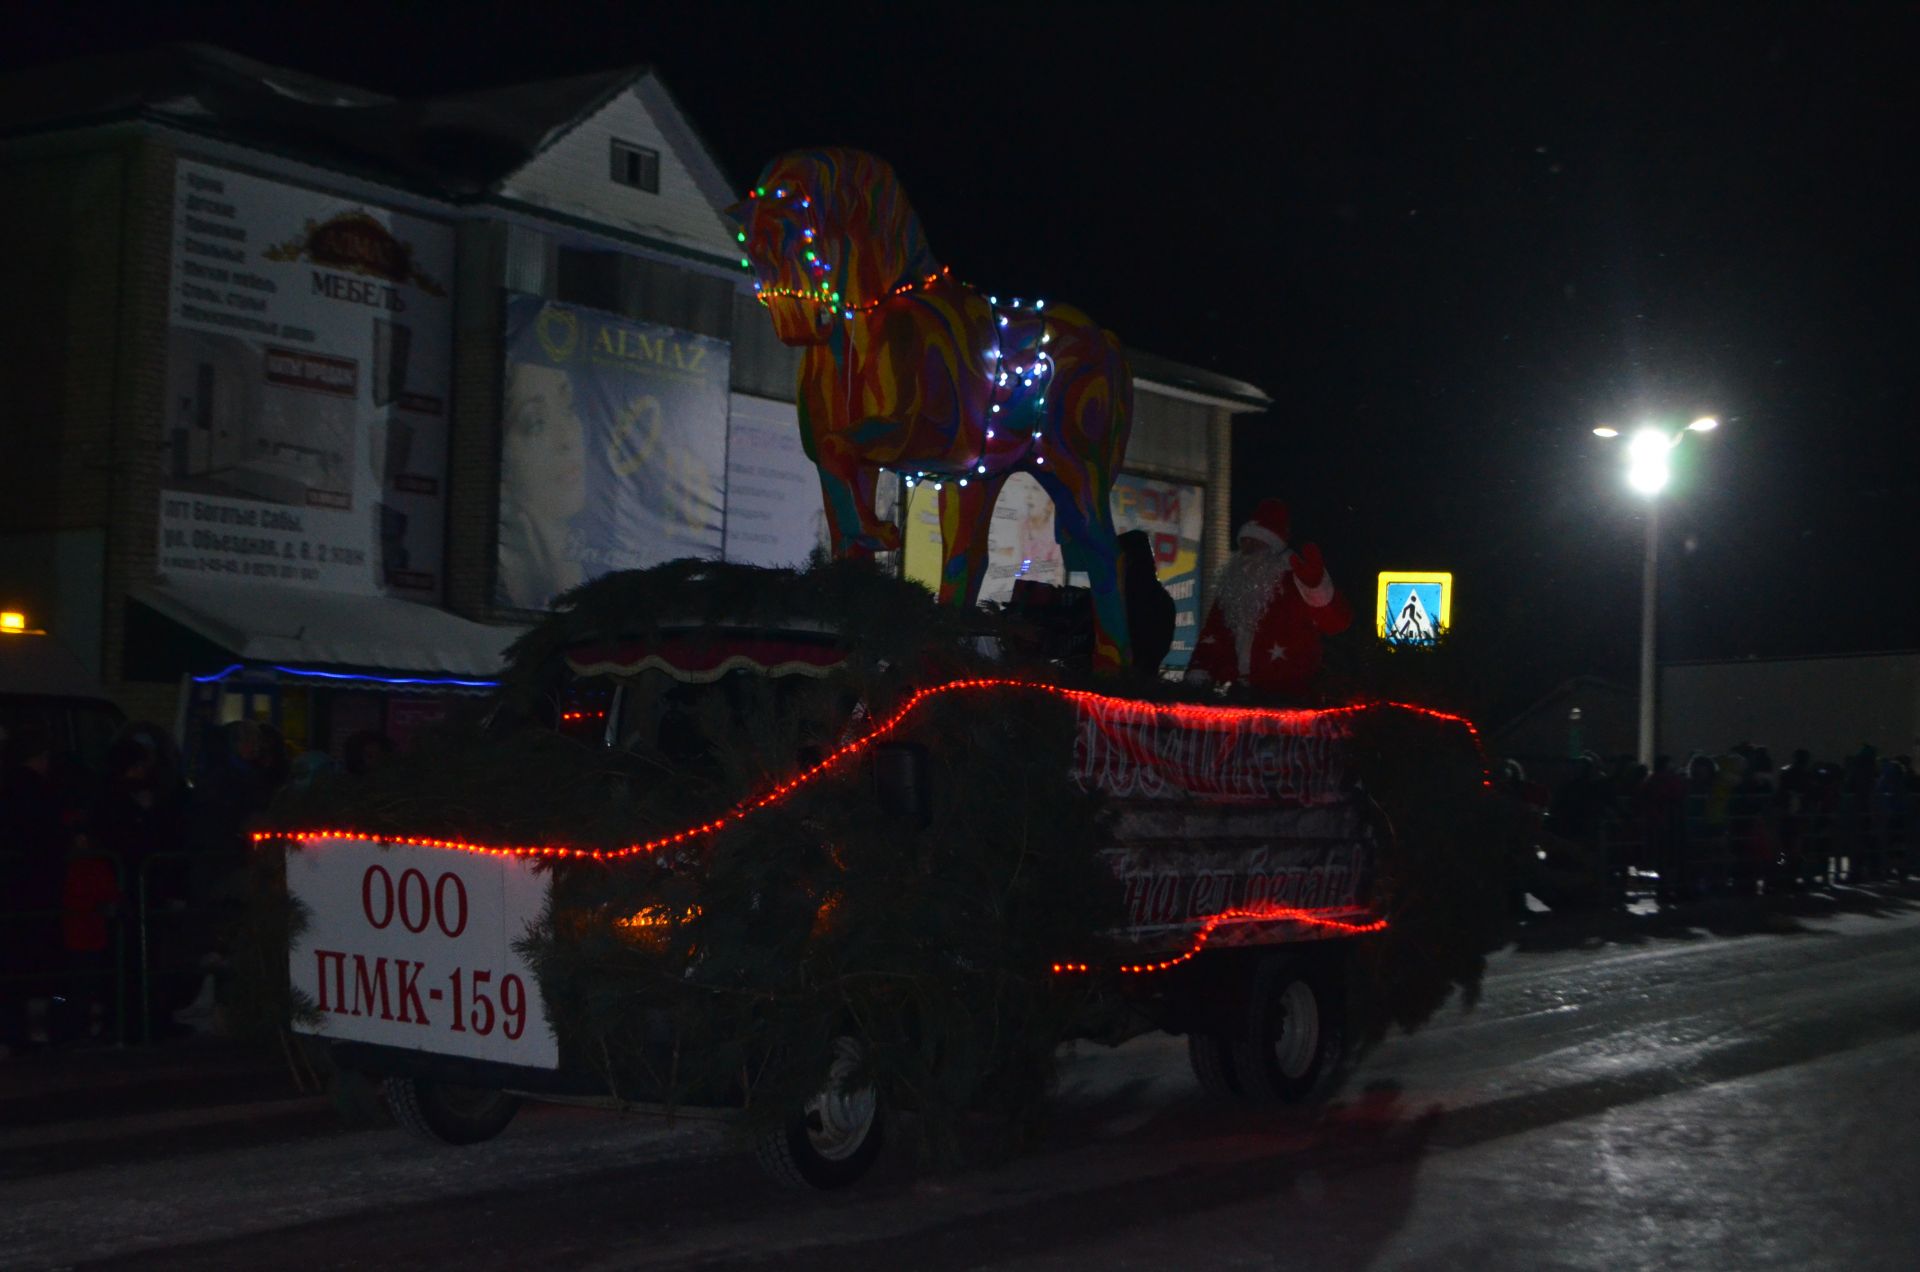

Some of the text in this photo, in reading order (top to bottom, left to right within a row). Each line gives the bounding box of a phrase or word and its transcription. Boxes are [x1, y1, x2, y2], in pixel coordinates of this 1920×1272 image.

[311, 270, 408, 313] МЕБЕЛЬ
[593, 326, 707, 373] ALMAZ
[362, 863, 469, 939] ООО
[314, 949, 527, 1041] ПМК-159
